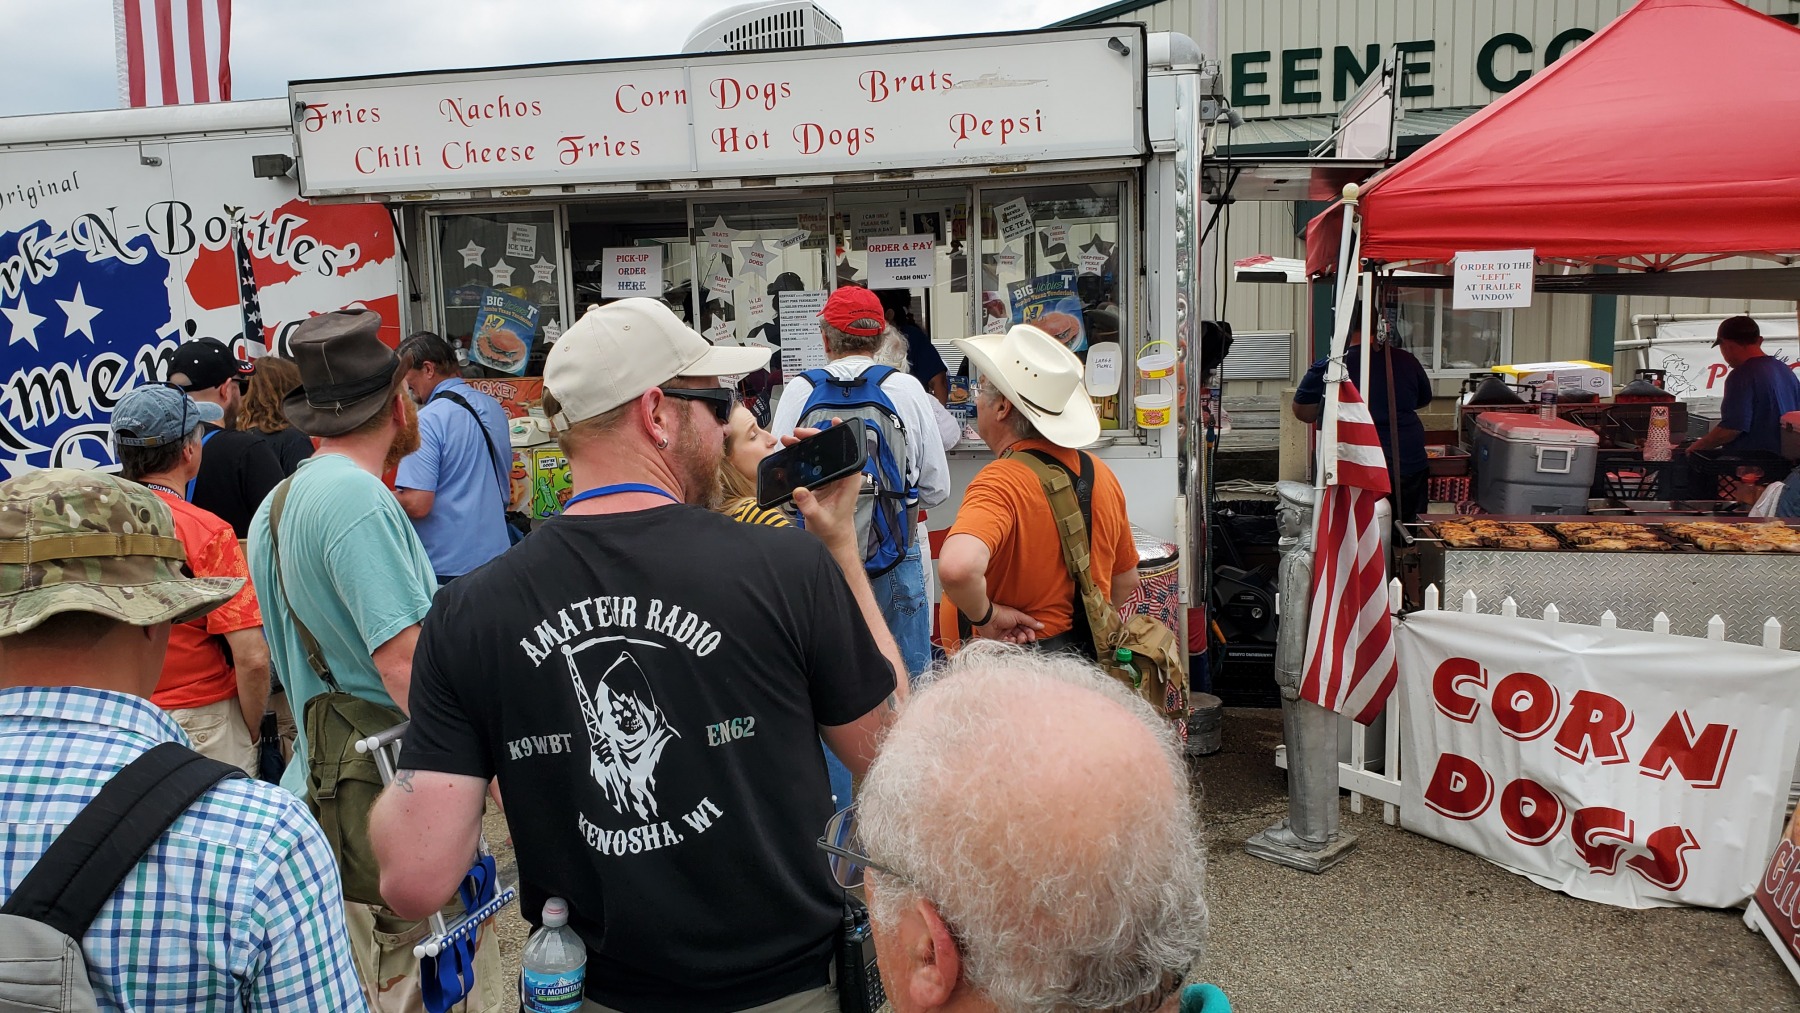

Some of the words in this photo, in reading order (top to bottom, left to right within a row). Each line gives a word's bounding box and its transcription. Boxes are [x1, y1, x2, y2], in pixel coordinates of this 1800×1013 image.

[304, 102, 381, 132] Fries
[439, 95, 542, 127] Nachos
[615, 84, 688, 114] Corn
[710, 78, 792, 110] Dogs
[858, 69, 952, 102] Brats
[355, 144, 422, 174] Chili
[442, 140, 536, 170] Cheese
[556, 135, 640, 166] Fries
[712, 127, 770, 152] Hot
[793, 123, 875, 156] Dogs
[950, 109, 1043, 149] Pepsi
[0, 171, 80, 210] riginal
[869, 244, 900, 252] ORDER
[912, 241, 933, 250] PAY
[1002, 224, 1015, 234] ICE
[1015, 219, 1031, 229] TEA
[885, 257, 916, 267] HERE
[618, 281, 647, 291] HERE
[520, 596, 636, 667] AMATEUR
[645, 598, 722, 657] RADIO
[507, 733, 572, 760] K9WBT
[706, 716, 755, 746] EN62
[1432, 657, 1738, 789] CORN
[578, 811, 685, 856] KENOSHA,
[682, 796, 724, 834] WI
[1424, 753, 1701, 891] DOGS
[547, 982, 581, 996] MOUNTAIN
